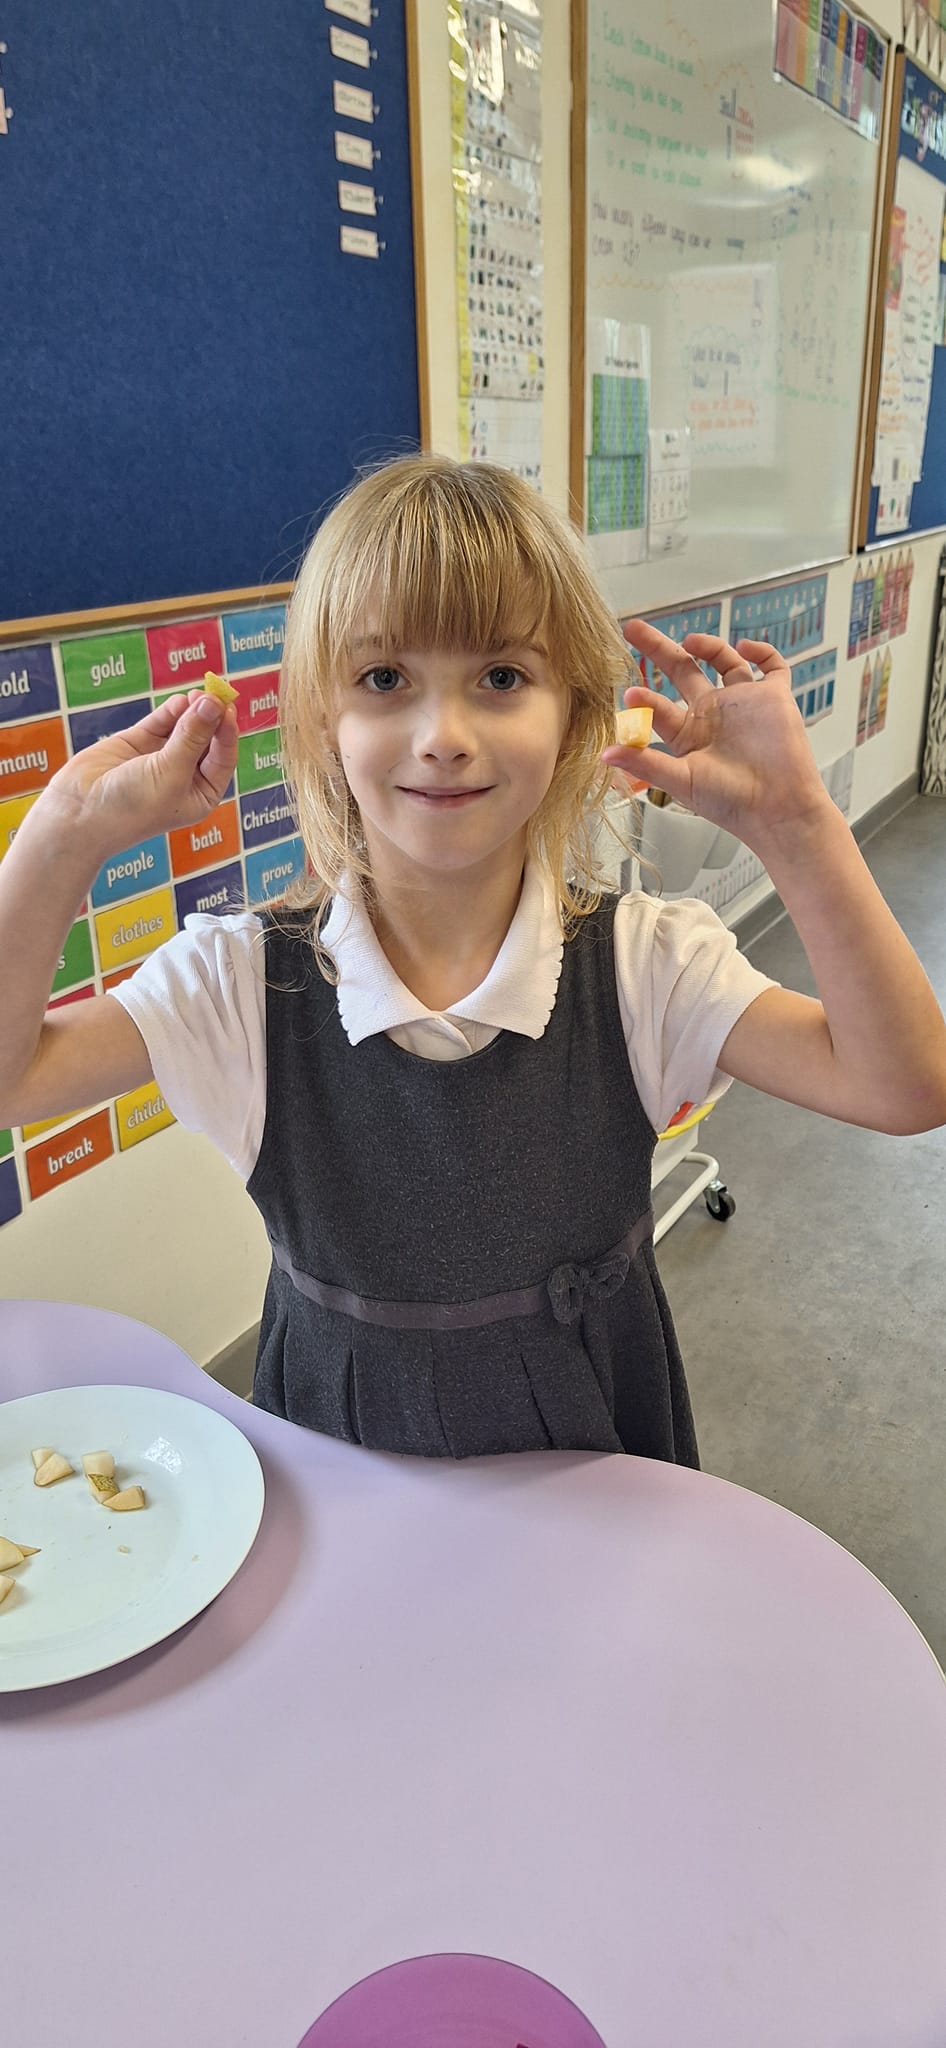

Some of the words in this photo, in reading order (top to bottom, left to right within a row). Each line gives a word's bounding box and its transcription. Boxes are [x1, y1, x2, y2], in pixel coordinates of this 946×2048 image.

[90, 653, 126, 687] gold
[168, 641, 207, 672] great
[229, 624, 285, 653] beautiful
[250, 689, 280, 718] path
[0, 750, 48, 776] many
[190, 826, 224, 852] bath
[243, 805, 291, 831] Christm
[107, 852, 155, 888] people
[262, 861, 294, 891] prove
[111, 915, 164, 947] clothes
[196, 889, 229, 913] most
[47, 1137, 94, 1175] break
[127, 1095, 165, 1129] child
